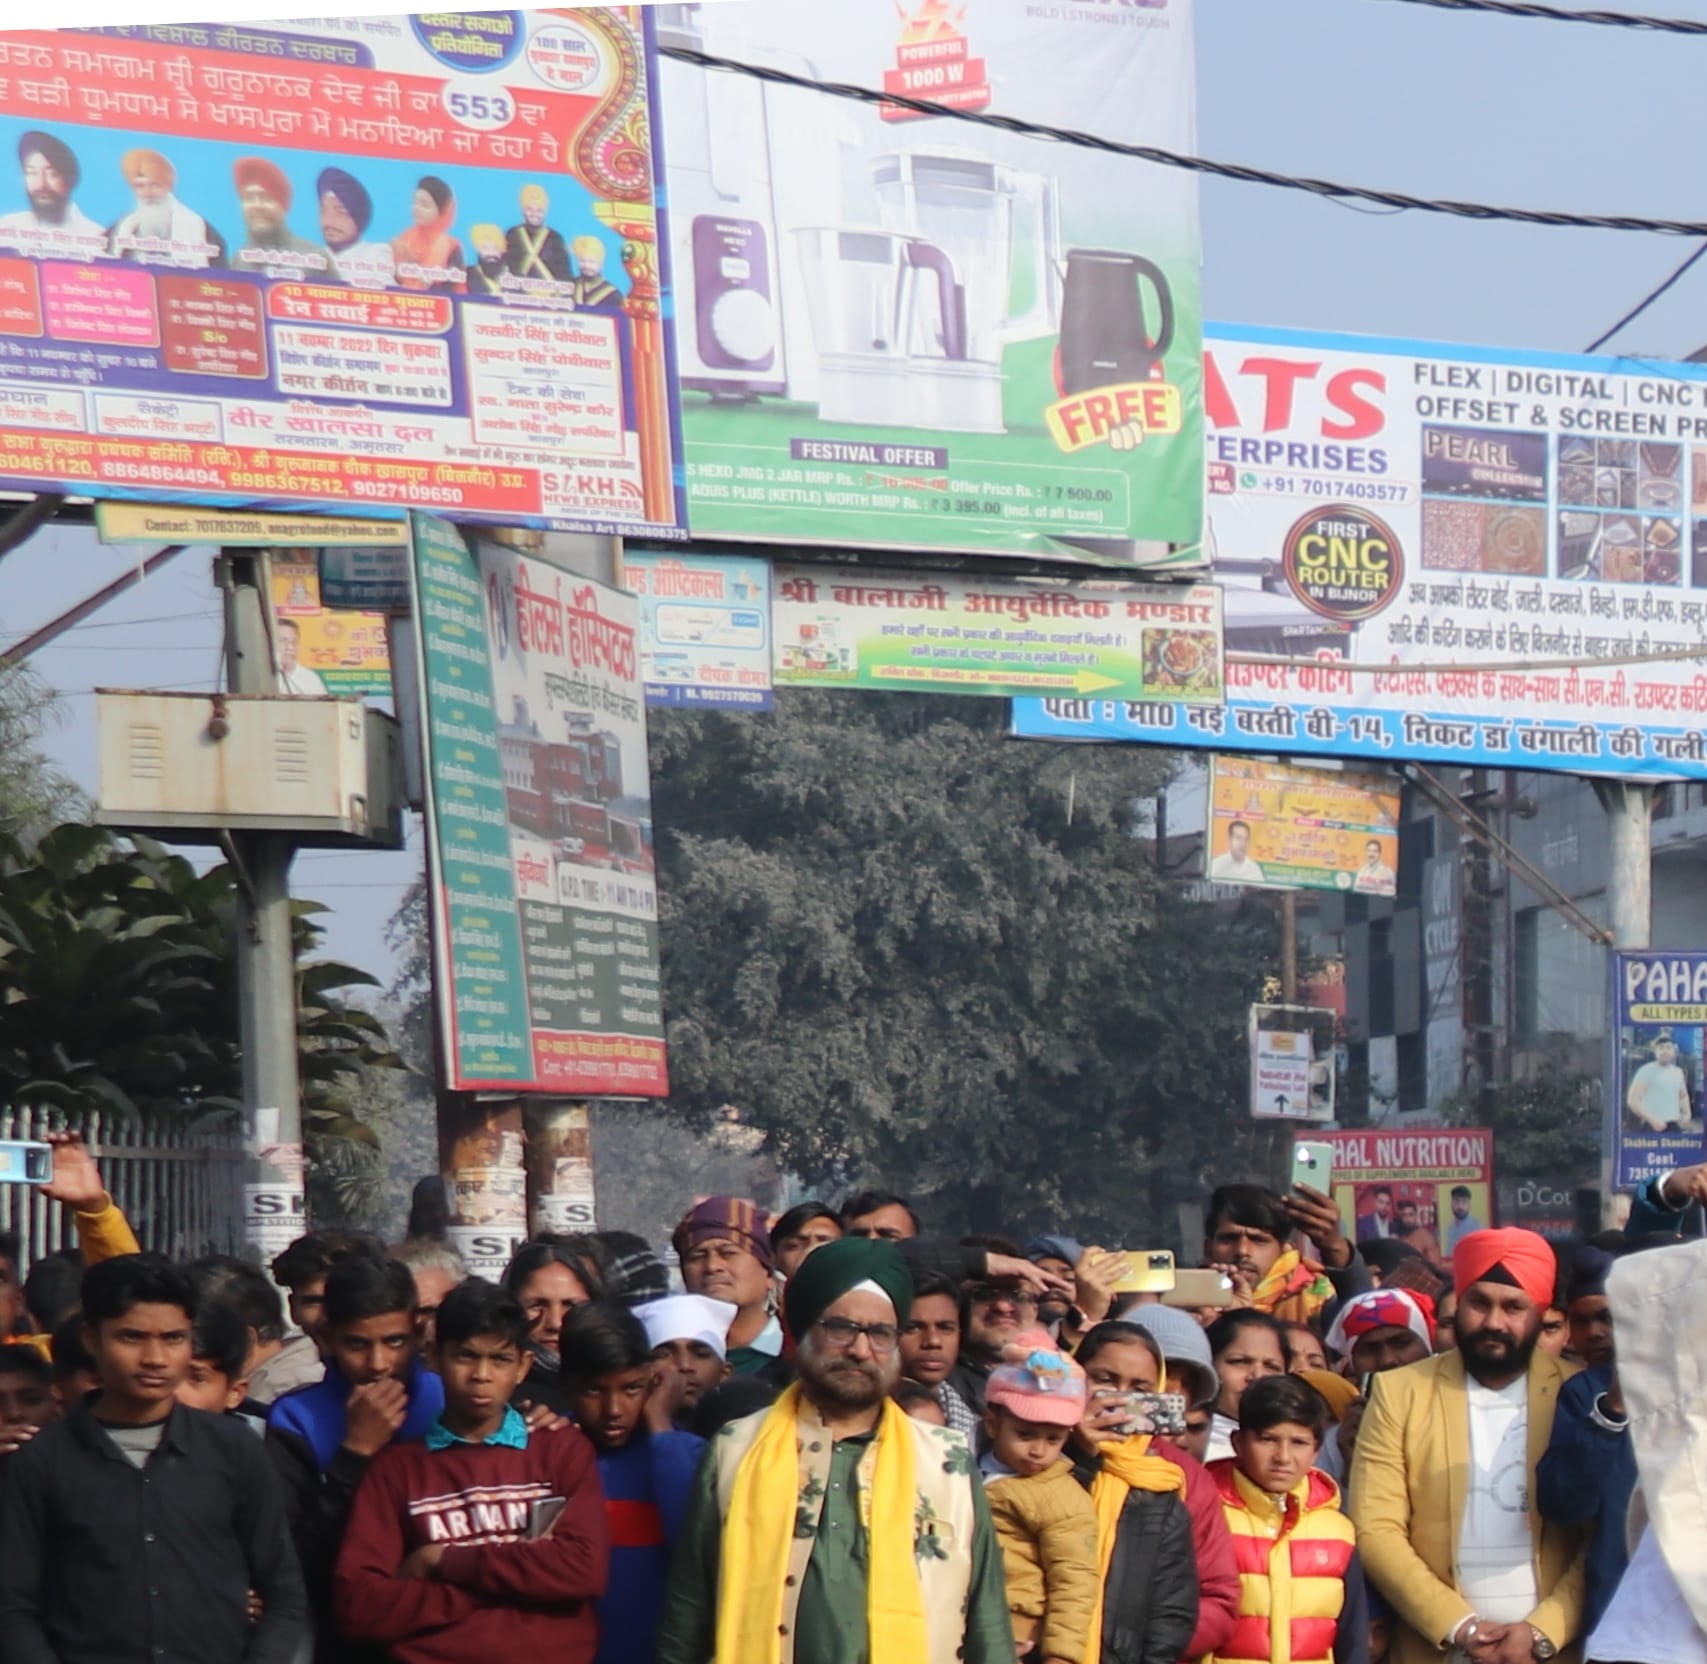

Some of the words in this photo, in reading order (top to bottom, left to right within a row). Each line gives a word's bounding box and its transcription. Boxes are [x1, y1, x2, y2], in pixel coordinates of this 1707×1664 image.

[901, 40, 964, 62] POWERFUL
[902, 68, 945, 89] 1000
[946, 63, 965, 83] W
[450, 92, 512, 123] 553
[1413, 362, 1482, 391] FLEX
[1506, 370, 1614, 401] DIGITAL
[1637, 381, 1693, 408] CNC
[228, 407, 274, 430] वीर
[284, 415, 384, 439] खालसा
[391, 424, 436, 444] दल
[1056, 387, 1168, 447] FREE
[1415, 394, 1521, 425] OFFSET
[1530, 404, 1549, 428] &
[1558, 406, 1668, 437] SCREEN
[801, 441, 879, 464] FESTIVAL
[883, 447, 937, 468] OFFER
[1207, 433, 1390, 476] ERPRISES
[1423, 428, 1519, 470] PEARL
[103, 461, 226, 488] 8864864494,
[353, 480, 464, 504] 9027109650
[777, 468, 804, 483] JAR
[804, 470, 835, 485] MRP
[950, 479, 981, 495] Offer
[983, 481, 1015, 496] Price
[1262, 475, 1296, 494] +91
[1301, 478, 1409, 503] 7017403577
[587, 495, 642, 510] EXPRESS
[733, 486, 766, 501] PLUS
[767, 488, 822, 506] (KETTLE)
[824, 491, 870, 507] WORTH
[871, 494, 901, 509] MRP
[954, 499, 1001, 515] 395.00
[1066, 507, 1104, 524] taxes)
[552, 519, 594, 533] Khalsa
[596, 522, 616, 535] Art
[1317, 520, 1372, 540] FIRST
[1298, 534, 1390, 571] CNC
[1298, 565, 1390, 590] ROUTER
[778, 579, 820, 606] श्री
[831, 583, 949, 614] बालाजी
[963, 586, 1112, 625] आयुर्वेदिक
[1126, 600, 1213, 625] भण्डार
[1308, 586, 1324, 599] IN
[1327, 587, 1379, 602] BIJNOR
[1235, 703, 1297, 737] बस्ती
[1305, 707, 1391, 748] बी-14,
[1403, 713, 1474, 749] निकट
[1518, 722, 1600, 756] बंगाली
[1608, 726, 1643, 759] की
[1641, 1006, 1662, 1020] ALL
[1666, 1006, 1701, 1020] TYPES
[1332, 1138, 1373, 1167] HAL
[1375, 1137, 1486, 1168] NUTRITION
[1647, 1152, 1679, 1166] Cont.
[429, 1500, 528, 1542] ARMAN
